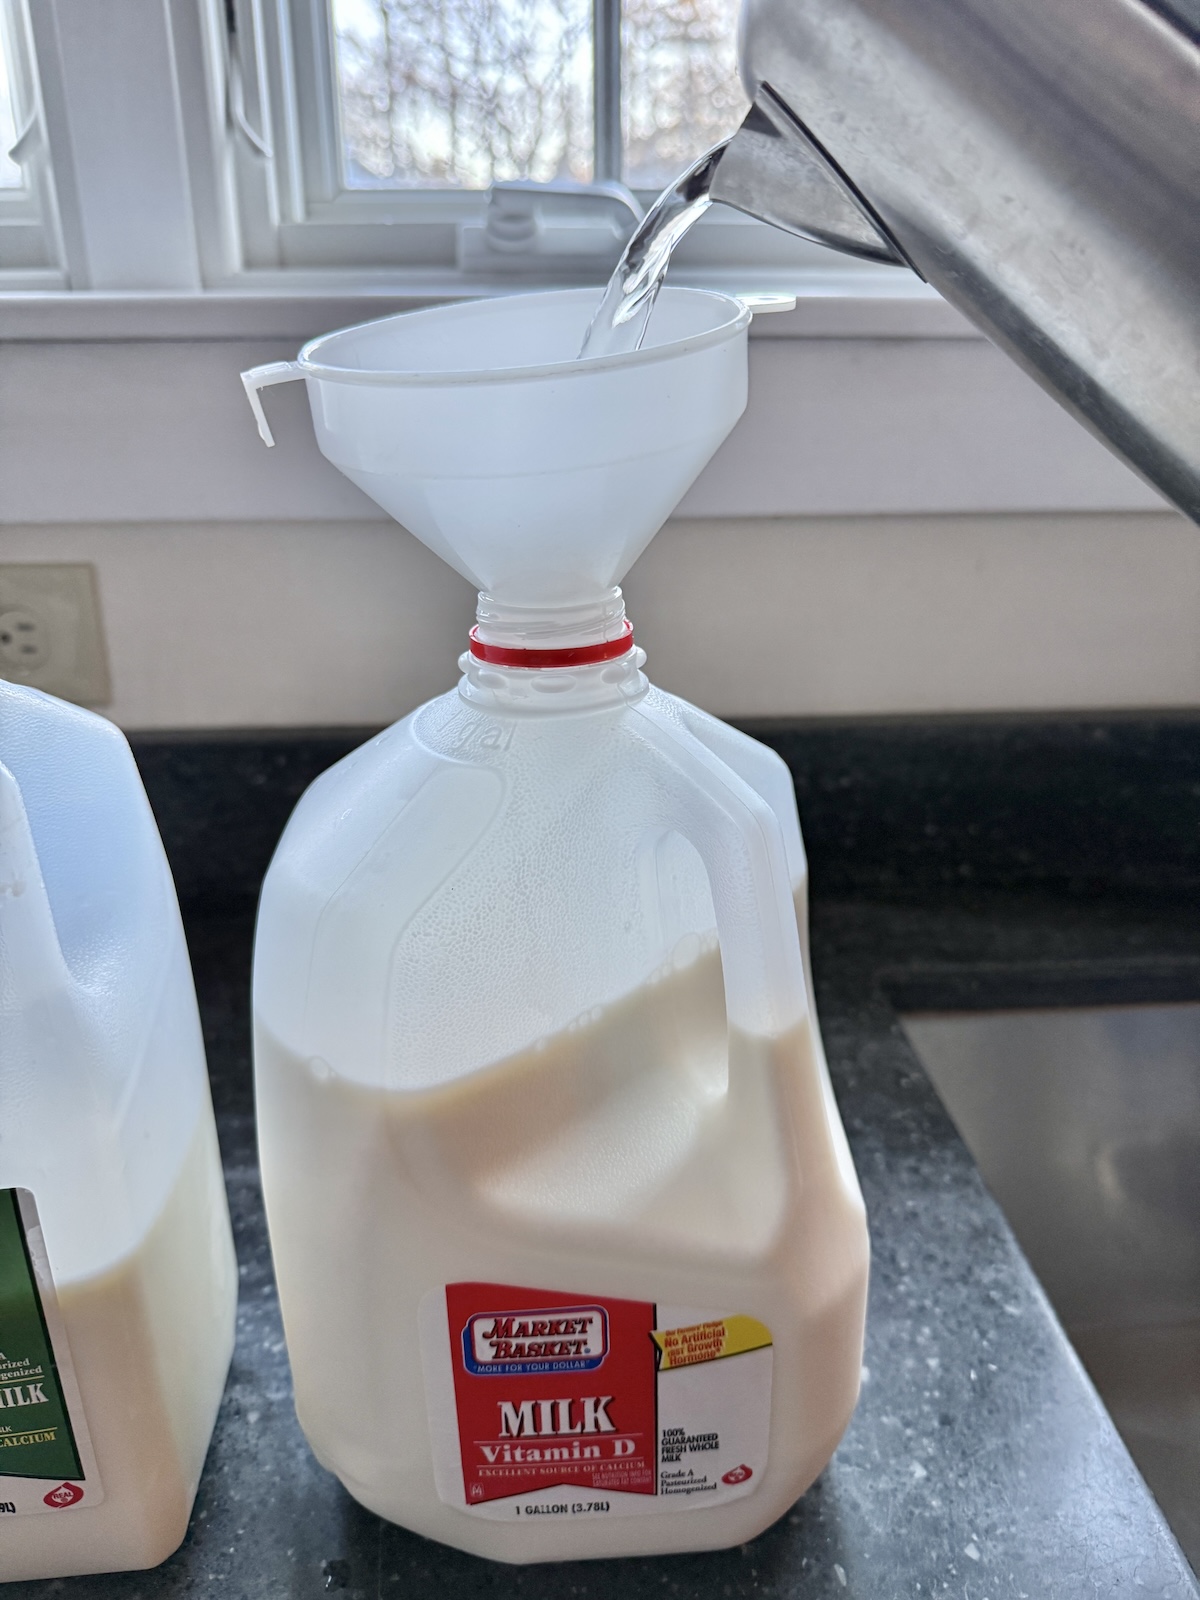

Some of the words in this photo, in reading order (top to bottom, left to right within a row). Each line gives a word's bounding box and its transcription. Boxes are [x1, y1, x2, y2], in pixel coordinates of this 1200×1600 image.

[482, 1316, 593, 1339] MARKET
[664, 1337, 679, 1348] No
[681, 1327, 726, 1345] Artificial
[687, 1338, 723, 1353] Growth
[0, 1358, 31, 1370] rized
[505, 1363, 522, 1372] FOR
[526, 1362, 550, 1371] YOUR
[0, 1383, 50, 1409] ILK
[497, 1396, 617, 1438] MILK
[661, 1433, 719, 1446] GUARANTEED
[662, 1428, 686, 1438] 100%
[479, 1440, 602, 1463] Vitamin
[612, 1439, 636, 1457] D
[661, 1445, 687, 1455] FRESH
[689, 1441, 720, 1453] WHOLE
[661, 1453, 682, 1463] MILK
[478, 1467, 537, 1477] EXCELLENT
[540, 1465, 579, 1475] SOURCE
[583, 1464, 597, 1472] OF
[600, 1461, 645, 1471] CALCIUM
[661, 1469, 686, 1479] Grade
[687, 1468, 694, 1477] A
[660, 1476, 707, 1487] Pasteurized
[660, 1482, 718, 1495] Homogenized
[53, 1491, 73, 1500] REAL
[515, 1505, 521, 1515] 1
[525, 1504, 568, 1515] GALLON
[572, 1501, 611, 1514] (3.78L)
